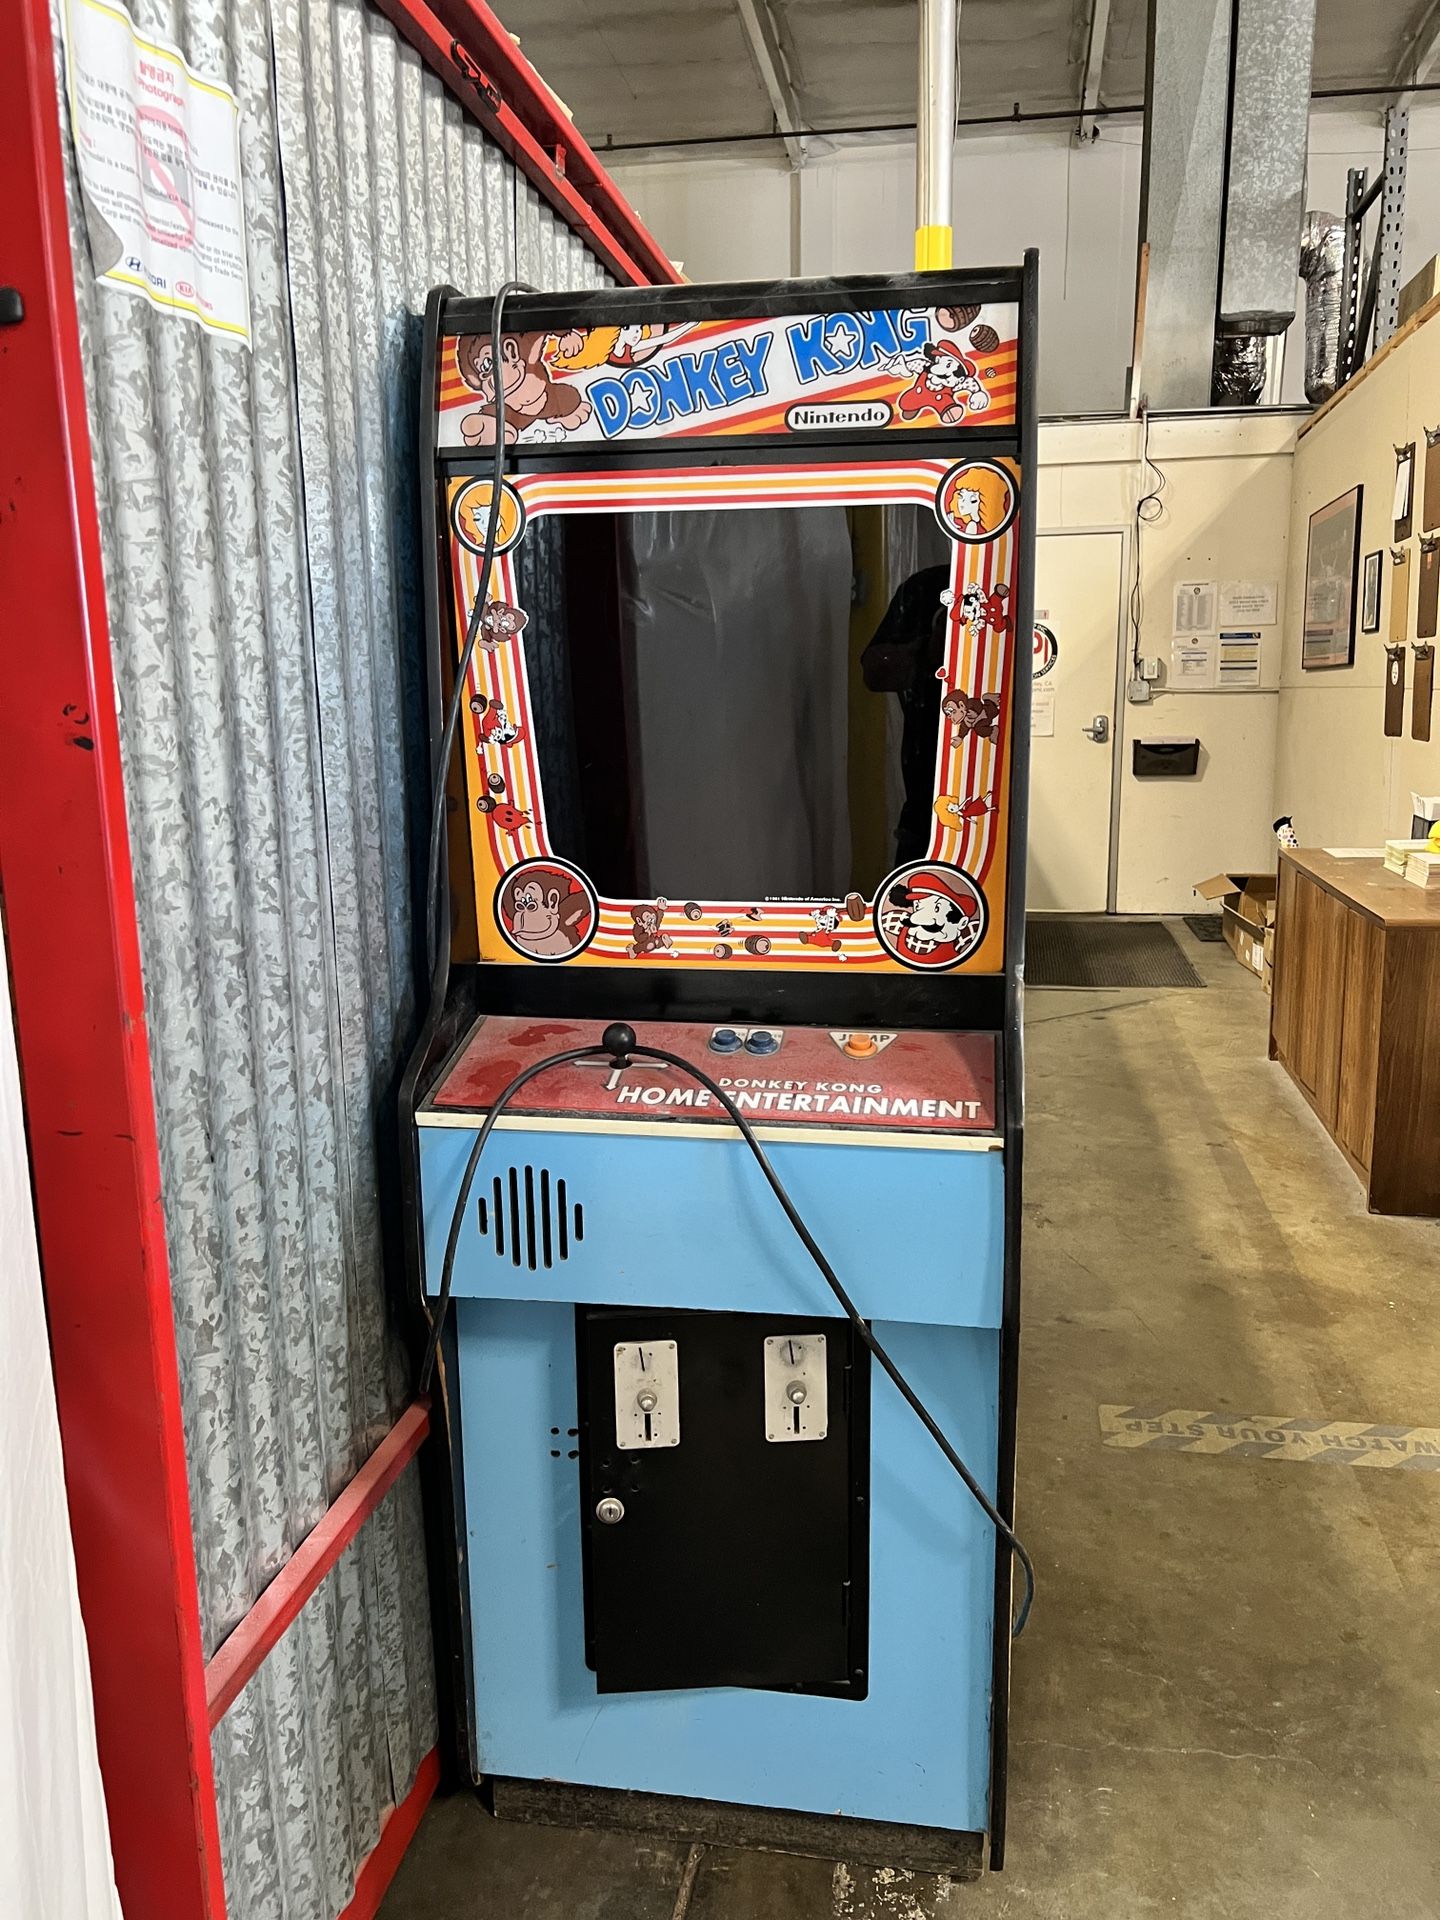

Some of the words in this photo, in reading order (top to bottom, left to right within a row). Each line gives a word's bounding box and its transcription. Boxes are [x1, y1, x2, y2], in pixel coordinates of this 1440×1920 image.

[586, 331, 774, 440] DONKEY
[785, 309, 931, 386] KONG
[794, 408, 885, 425] Nintendo
[839, 1033, 890, 1042] JMP
[719, 1077, 809, 1091] DONKEY
[815, 1082, 883, 1094] KONG
[617, 1085, 711, 1107] HOME
[1125, 1420, 1204, 1437] STEP
[1215, 1425, 1311, 1446] YOUR
